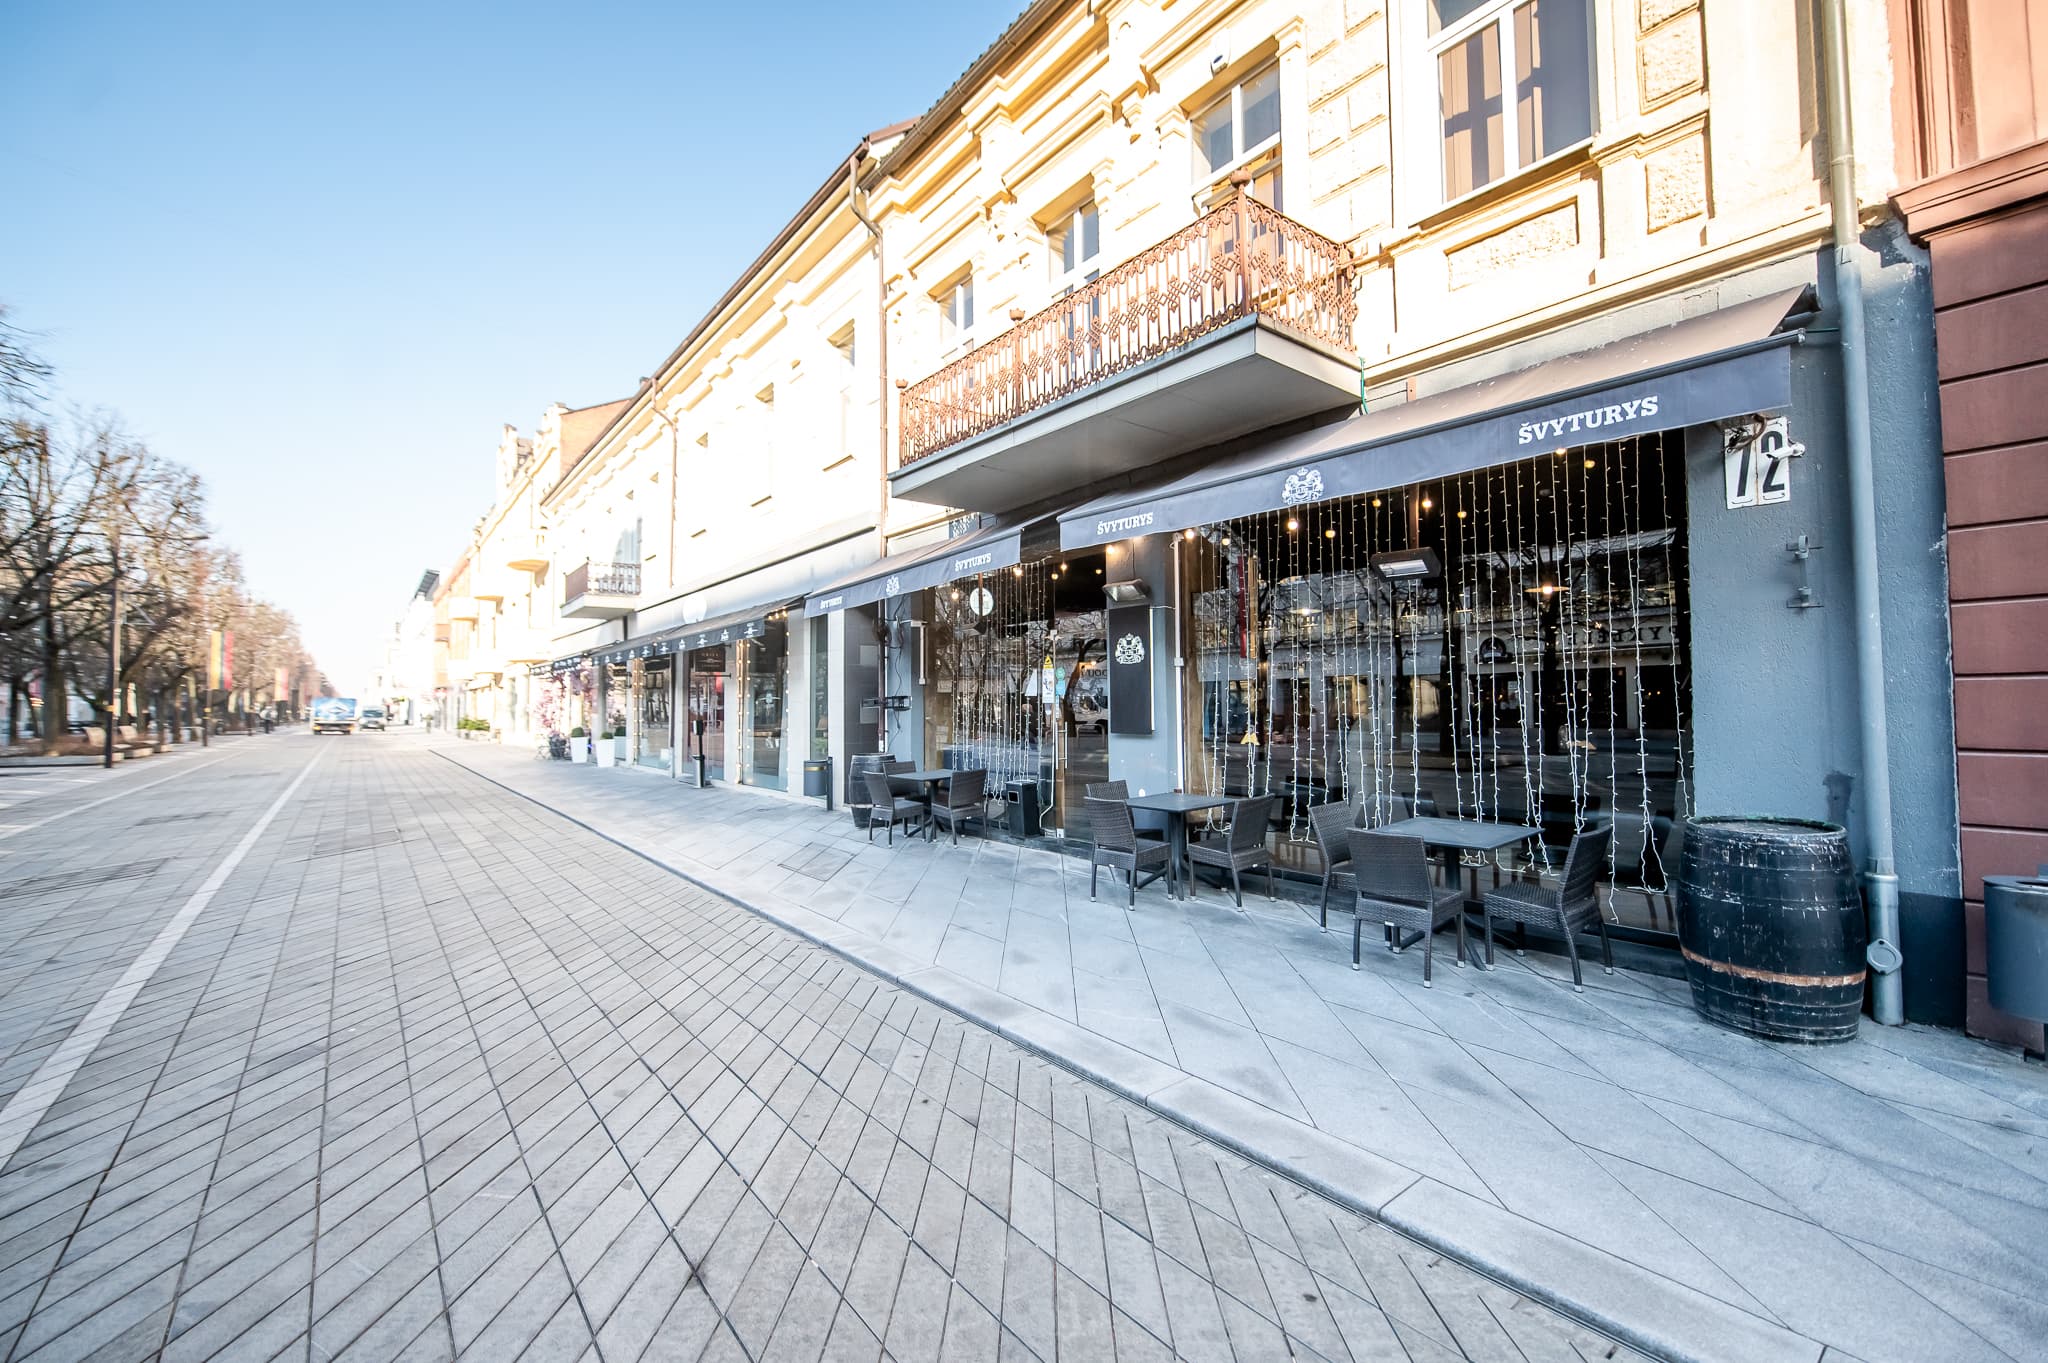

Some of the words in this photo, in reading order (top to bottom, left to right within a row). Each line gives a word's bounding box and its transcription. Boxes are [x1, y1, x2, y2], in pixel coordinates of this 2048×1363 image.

[1518, 395, 1659, 445] ŠVYTURYS
[1096, 511, 1154, 536] ŠVYTURYS
[954, 552, 992, 573] ŠVYTURYS
